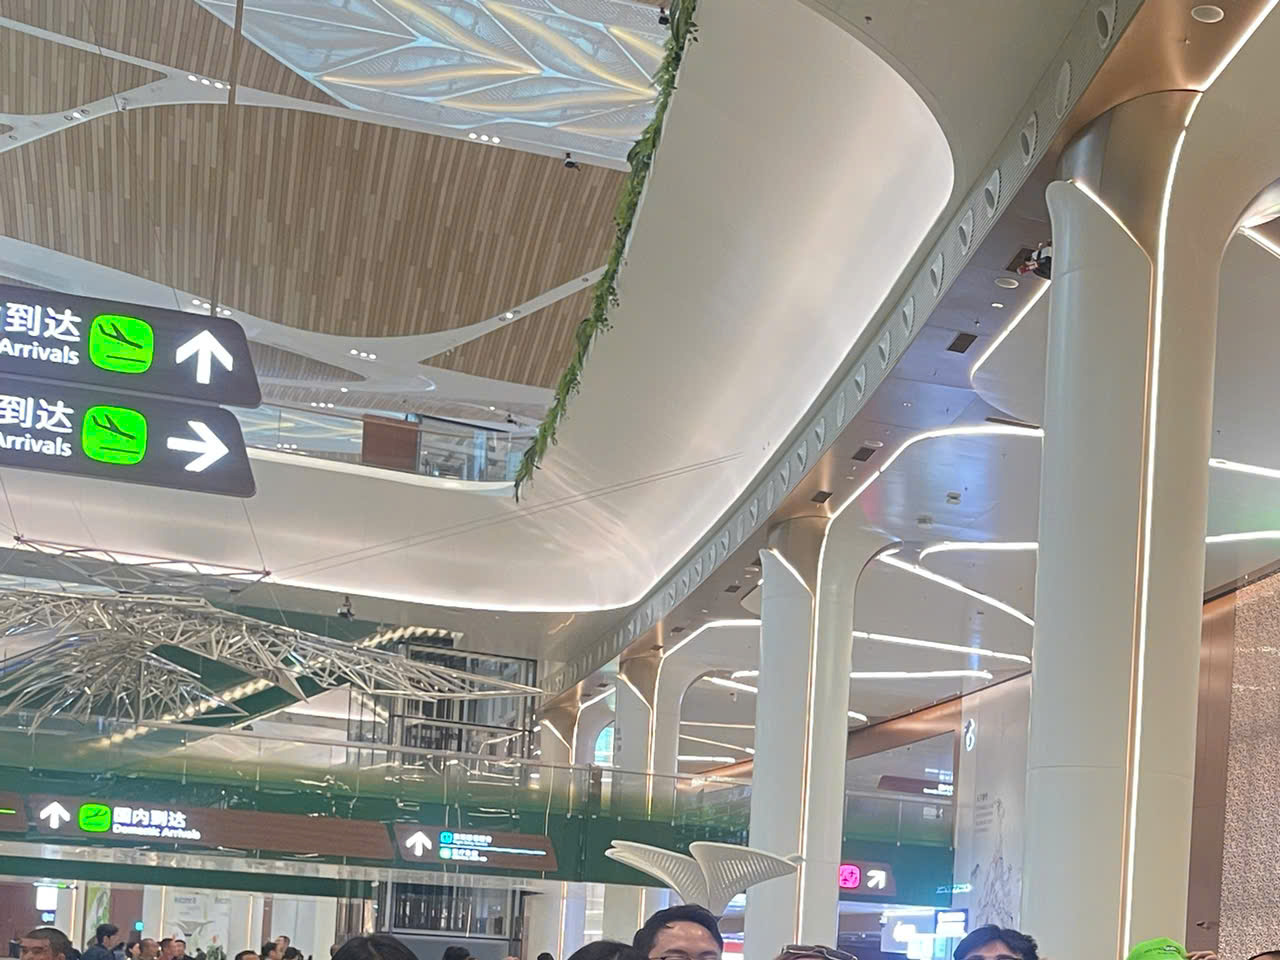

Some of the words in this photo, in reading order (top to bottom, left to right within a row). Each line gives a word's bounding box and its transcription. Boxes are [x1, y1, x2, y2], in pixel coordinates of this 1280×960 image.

[0, 303, 81, 342] 到达
[0, 338, 80, 365] Arrivals
[0, 395, 74, 433] 到达
[113, 806, 187, 829] 国内到达
